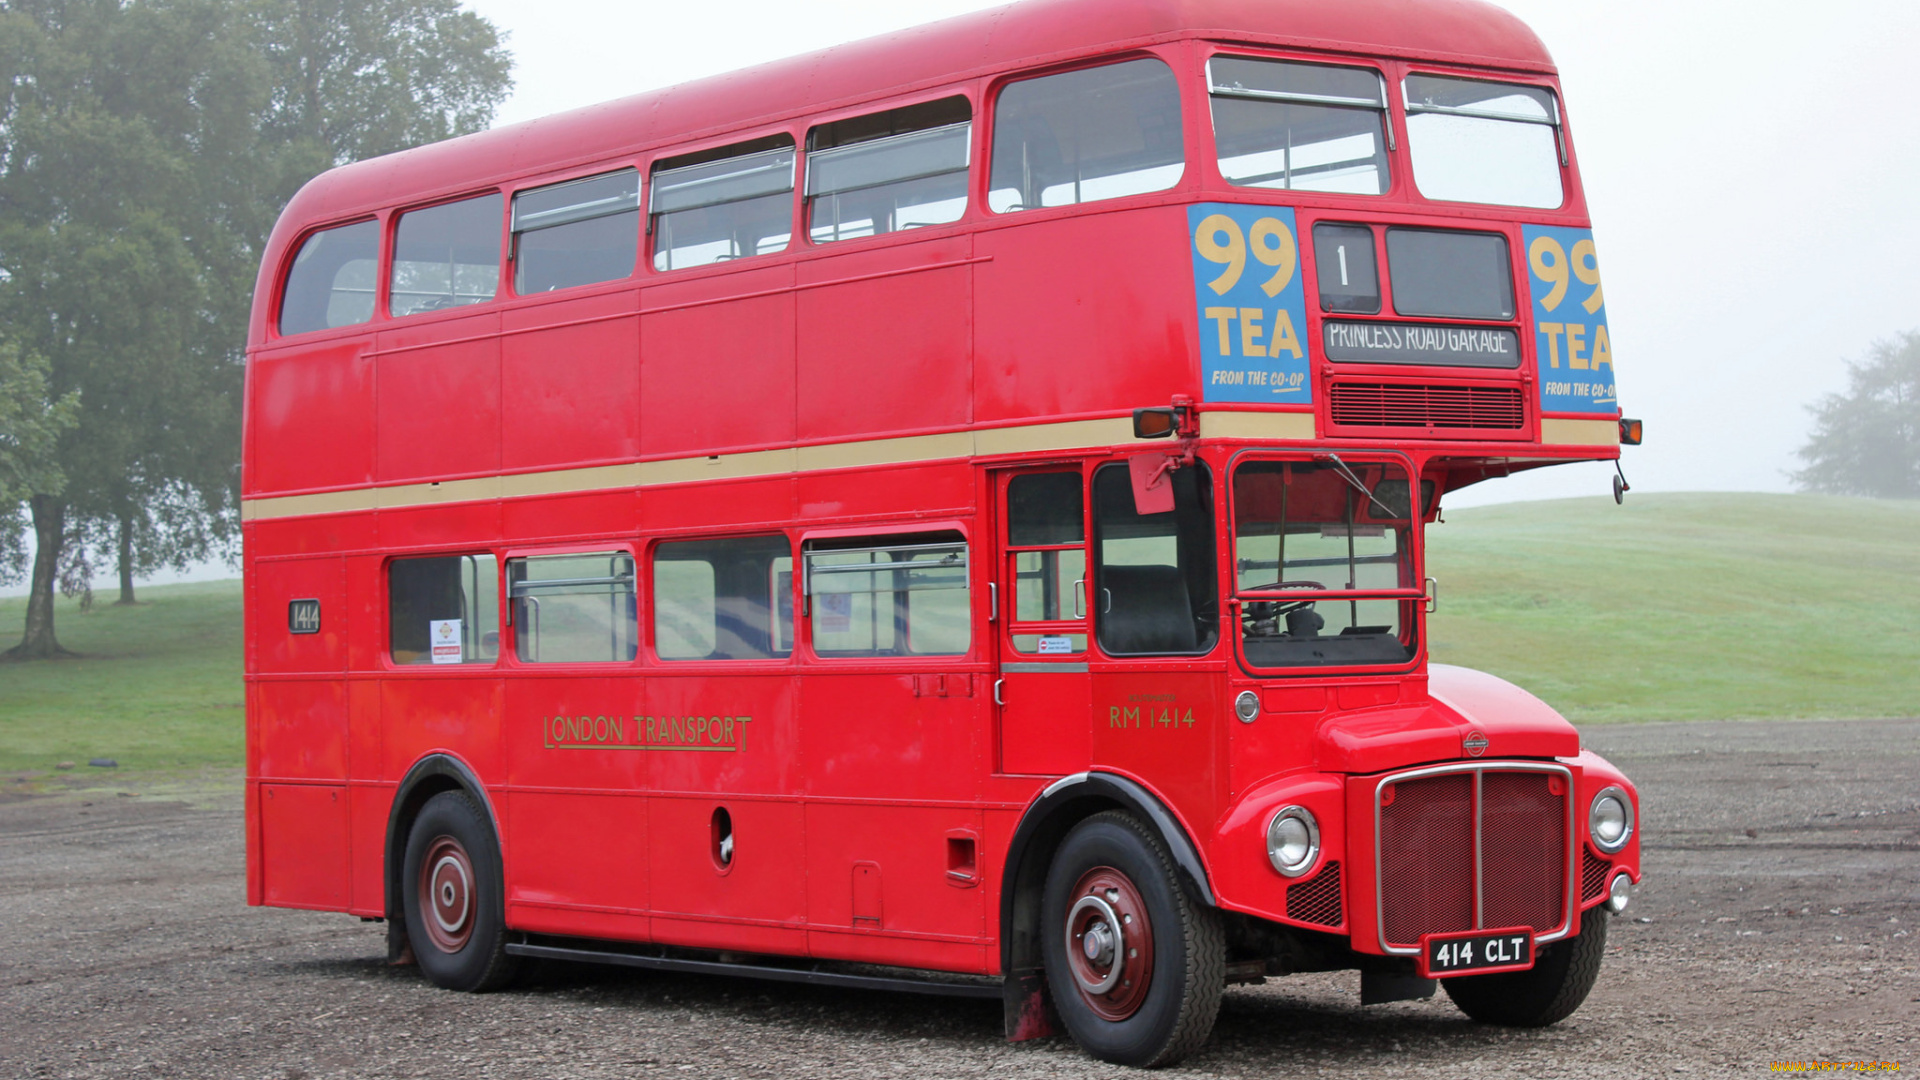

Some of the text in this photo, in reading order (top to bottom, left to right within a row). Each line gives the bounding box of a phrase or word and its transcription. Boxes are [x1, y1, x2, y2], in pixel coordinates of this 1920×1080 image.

[1195, 214, 1297, 299] 99
[1337, 245, 1349, 286] 1
[1529, 235, 1604, 315] 99
[1204, 306, 1304, 360] TEA
[1330, 323, 1508, 353] PRINCESS ROAD GARAGE
[1539, 321, 1614, 372] TEA
[1211, 370, 1244, 385] FROM
[1247, 371, 1268, 386] THE
[1545, 381, 1571, 396] FROM
[1573, 382, 1590, 396] THE
[294, 604, 320, 629] 1414
[544, 715, 752, 752] LONDON TRANSPORT
[1110, 706, 1196, 729] RM 1414
[1436, 937, 1524, 967] 414 CLT
